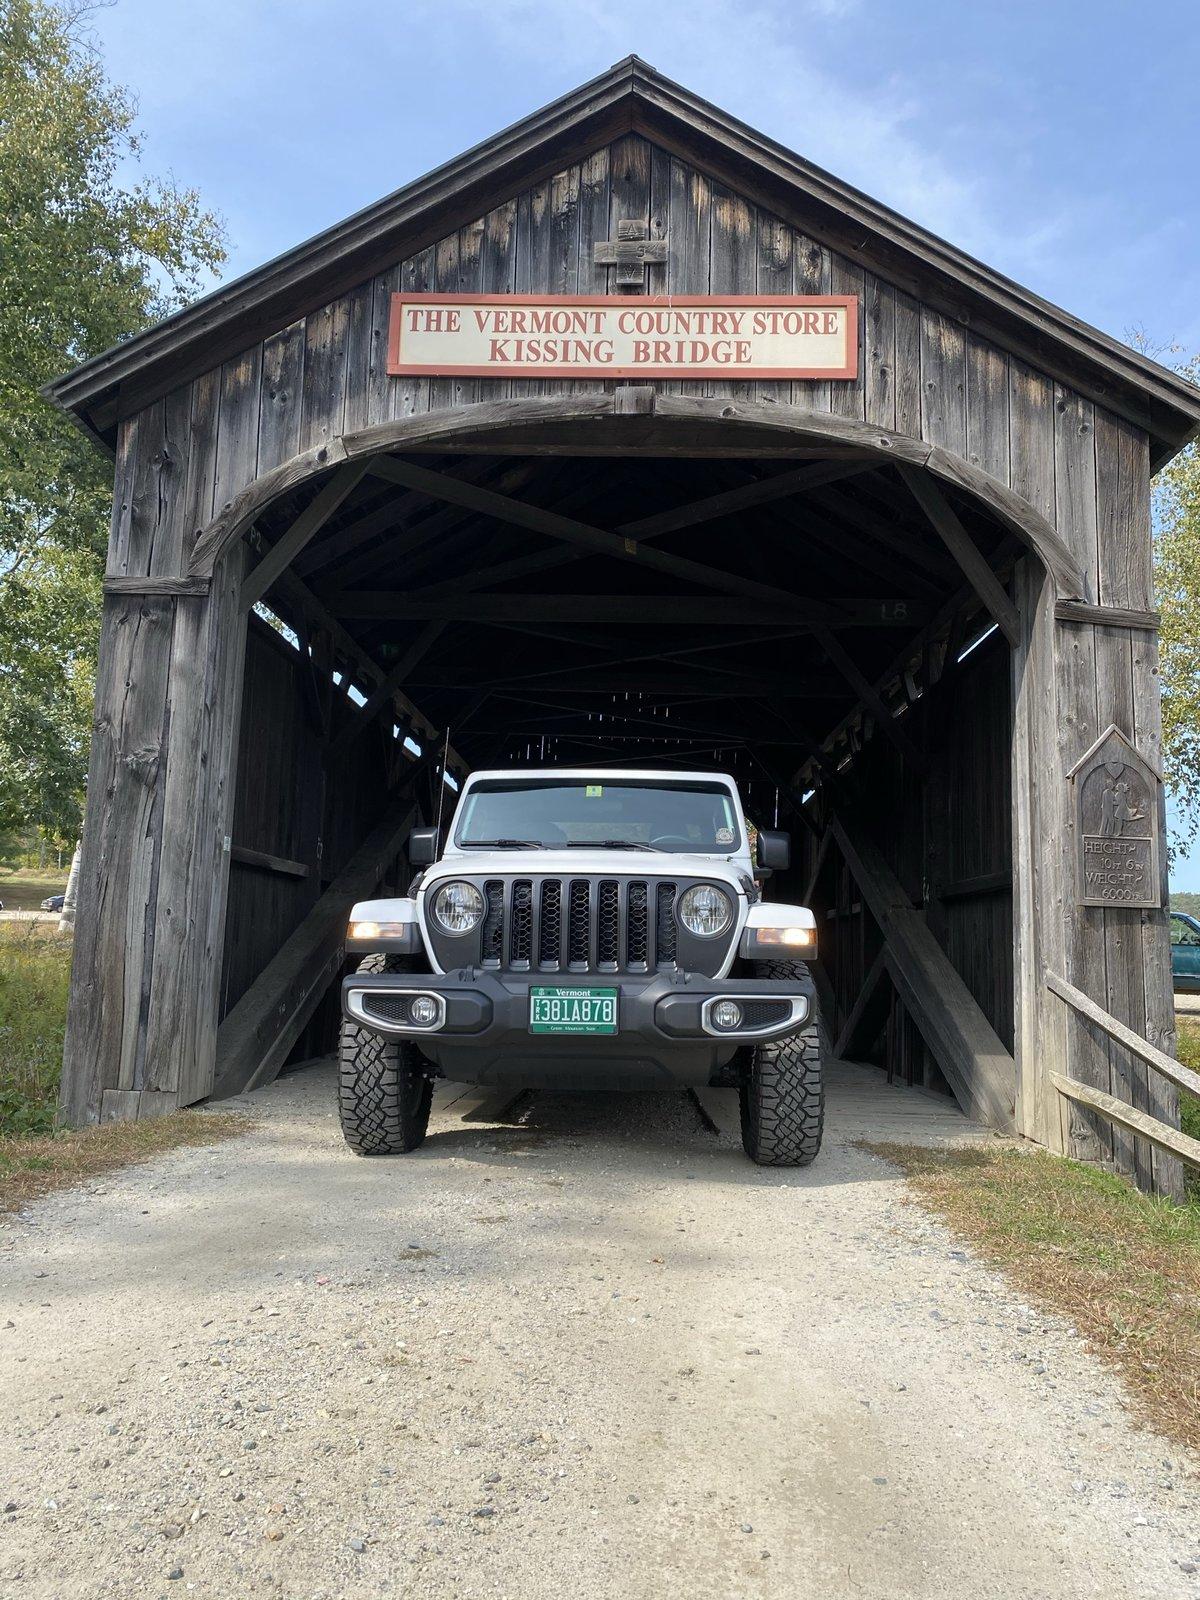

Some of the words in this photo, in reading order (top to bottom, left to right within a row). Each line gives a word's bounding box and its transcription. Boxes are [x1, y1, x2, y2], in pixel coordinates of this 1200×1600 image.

[407, 309, 461, 333] THE
[473, 310, 607, 334] VERMONT
[618, 311, 746, 335] COUNTRY
[752, 311, 838, 335] STORE
[487, 338, 615, 363] KISSING
[631, 340, 752, 364] BRIDGE
[556, 988, 591, 997] Vermont
[541, 999, 612, 1021] 381A878
